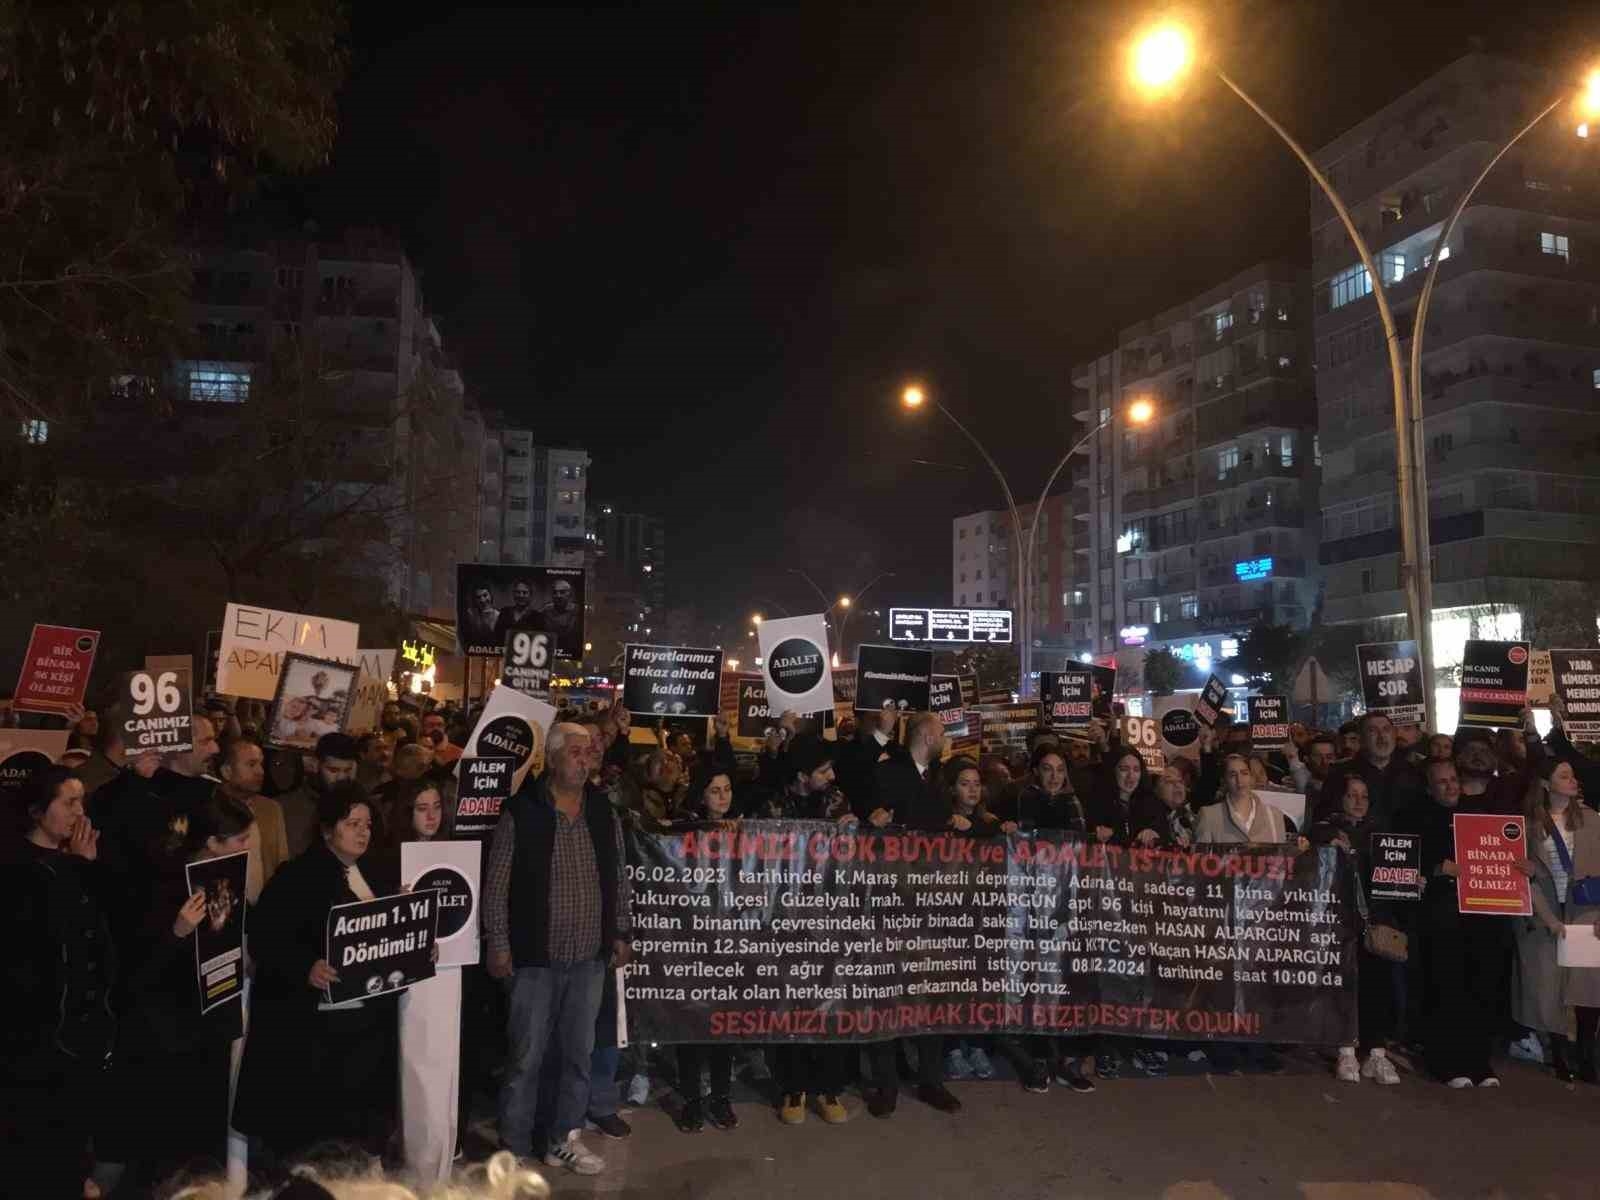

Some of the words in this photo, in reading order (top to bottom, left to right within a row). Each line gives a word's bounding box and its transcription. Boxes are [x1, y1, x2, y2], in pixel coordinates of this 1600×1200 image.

[512, 632, 549, 668] 96
[632, 648, 715, 664] Hayatlarımız
[773, 654, 819, 669] ADALET
[1366, 657, 1414, 676] HESAP
[1567, 659, 1592, 671] YARA
[504, 665, 550, 681] CANIMIZ
[628, 665, 668, 678] enkaz
[670, 667, 715, 680] altında
[130, 671, 181, 715] 96
[651, 682, 685, 696] kaldı
[687, 684, 696, 696] !!
[930, 682, 953, 694] İLEM
[1377, 679, 1409, 697] SOR
[1566, 688, 1600, 699] MERHE
[1054, 702, 1091, 717] ADALET
[124, 715, 190, 732] CANIMIZ
[1127, 718, 1156, 746] 96
[1252, 723, 1289, 739] ADALET
[138, 728, 179, 745] GİTTİ
[482, 732, 530, 757] ADALET
[469, 760, 506, 774] AİLEM
[473, 776, 499, 791] İÇİN
[457, 797, 507, 816] ADALE
[1379, 837, 1413, 849] AİLEM
[1480, 834, 1501, 846] BİR
[808, 831, 877, 865] ÇOK
[883, 830, 976, 864] BÜYÜK
[978, 844, 1005, 862] ve
[1012, 839, 1123, 868] ADALET
[1384, 849, 1407, 862] İÇİN
[1467, 849, 1516, 861] BİNADA
[1371, 867, 1418, 884] ADALET
[1470, 864, 1483, 875] 96
[1486, 863, 1511, 878] KİŞİ
[738, 868, 824, 884] tarihinde
[834, 869, 899, 888] K.Maraş
[907, 870, 969, 885] merkezli
[976, 870, 1057, 889] depremde
[1143, 879, 1196, 897] sadece
[1206, 884, 1224, 899] 11
[1234, 886, 1274, 901] bina
[1283, 888, 1341, 905] yıkıldı.
[1469, 877, 1517, 891] ÖLMEZ!
[723, 890, 769, 910] ilçesi
[781, 890, 860, 911] Güzelyalı
[871, 892, 905, 907] mah.
[916, 891, 964, 907] HASAN
[971, 890, 1057, 909] ALPARGÜN
[1068, 897, 1093, 912] apt
[1102, 897, 1122, 912] 96
[1131, 898, 1154, 917] kişi
[1163, 901, 1225, 920] hayatını
[1235, 905, 1341, 926] kaybetmiştir.
[333, 908, 387, 937] Acının
[391, 906, 407, 925] 1.
[409, 898, 430, 920] Yıl
[629, 912, 682, 930] ıkılan
[692, 914, 762, 931] binanın
[771, 914, 876, 934] çevresindeki
[882, 914, 927, 933] hiçbir
[928, 913, 975, 929] binada
[982, 914, 1018, 929] saksı
[1029, 915, 1059, 930] bile
[1154, 921, 1206, 939] HASAN
[1214, 926, 1301, 943] ALPARGÜN
[1310, 932, 1341, 947] apt.
[342, 924, 416, 967] Dönümü
[417, 929, 428, 949] !!
[632, 938, 708, 956] epremin
[713, 938, 839, 958] 12.Saniyesinde
[843, 938, 883, 957] yerle
[886, 937, 904, 952] bir
[905, 935, 970, 952] olmuştur.
[974, 934, 1035, 953] Deprem
[1039, 936, 1082, 954] günü
[1150, 942, 1192, 960] Kaçan
[1195, 944, 1250, 961] HASAN
[1254, 946, 1341, 965] ALPARGÜN
[624, 960, 651, 979] çin
[663, 961, 745, 978] verilecek
[756, 963, 778, 977] en
[789, 961, 824, 980] ağır
[834, 962, 896, 977] cezanın
[901, 957, 977, 973] verilmesini
[987, 957, 1062, 974] istiyoruz.
[1158, 963, 1224, 981] tarihinde
[1233, 969, 1267, 984] saat
[1272, 969, 1317, 985] 10:00
[1322, 972, 1343, 987] da
[626, 984, 686, 1001] cımıza
[690, 984, 738, 1001] ortak
[743, 984, 781, 1000] olan
[785, 984, 848, 1001] herkesi
[852, 983, 904, 1000] binanın
[982, 977, 1071, 997] bekliyoruz.
[710, 1006, 828, 1035] SESİMİZİ
[836, 1002, 962, 1035] DUYURMAK
[968, 998, 1023, 1030] İÇİN
[1087, 1002, 1181, 1031] DESTEK
[1185, 1008, 1260, 1034] OLUN!
